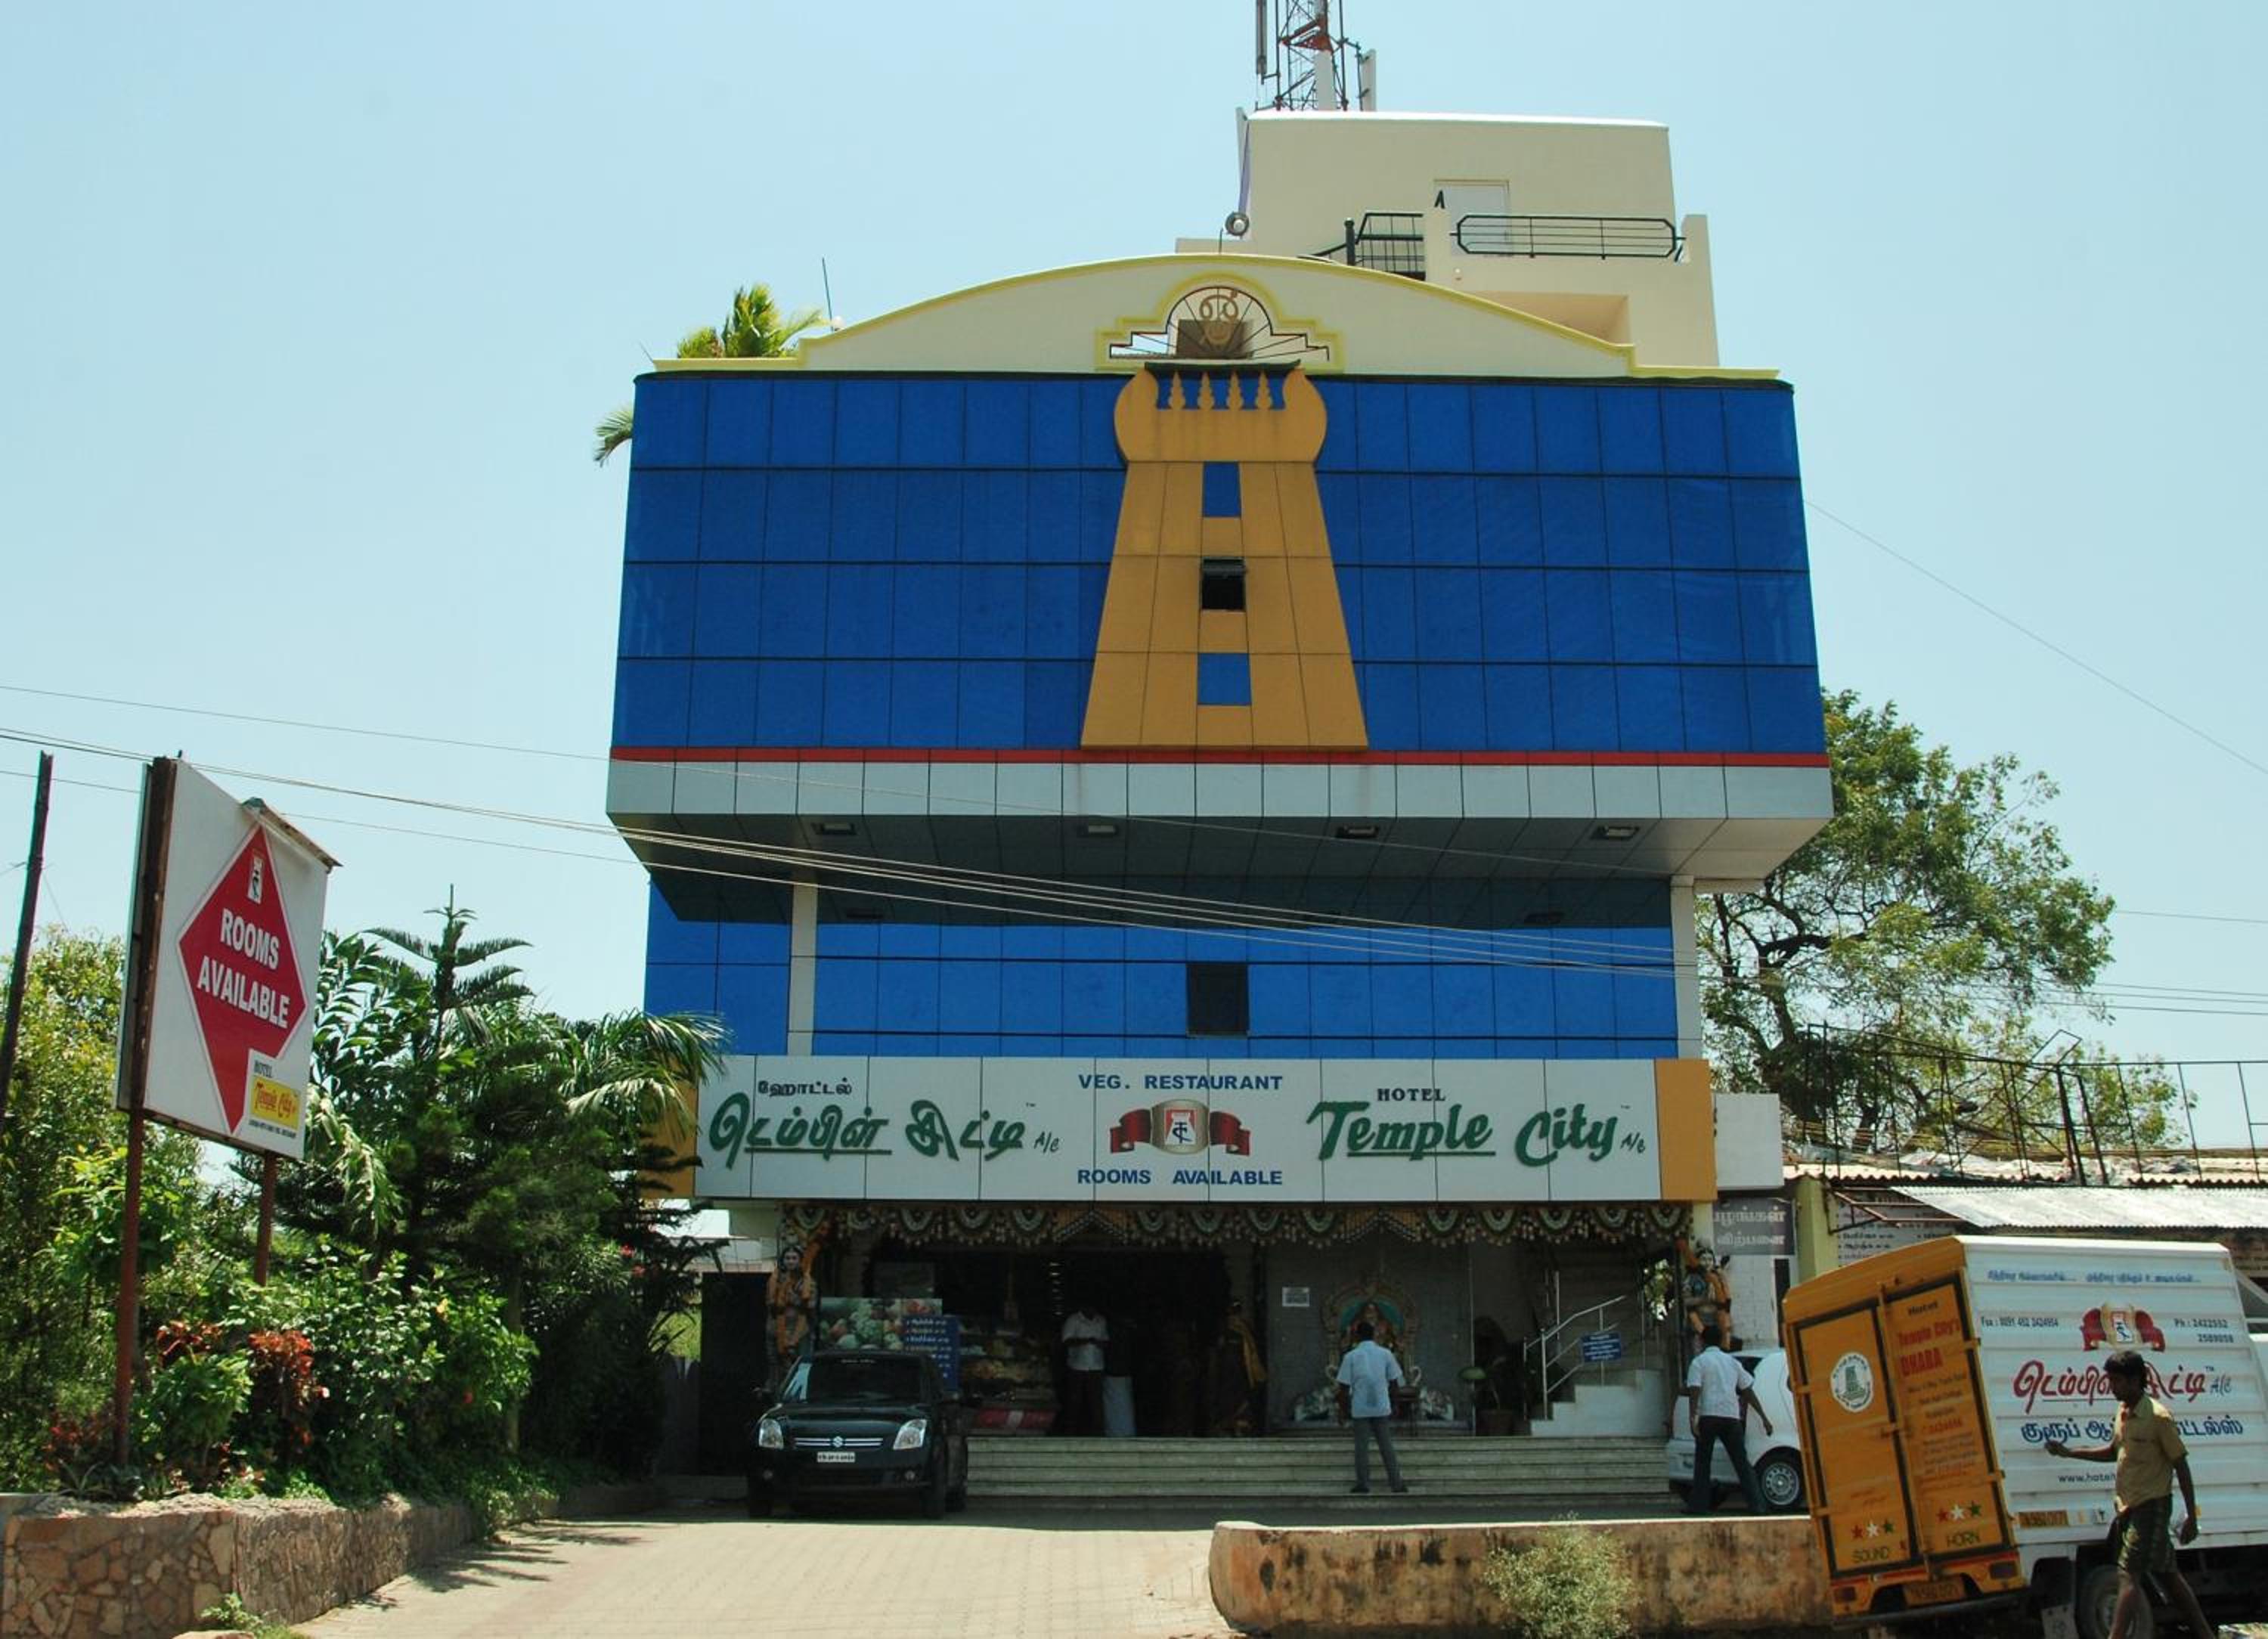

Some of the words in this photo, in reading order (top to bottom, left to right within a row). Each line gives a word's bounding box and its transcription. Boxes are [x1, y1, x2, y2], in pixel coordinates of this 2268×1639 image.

[220, 908, 279, 970] ROOMS
[197, 956, 290, 1029] AVAILABLE
[758, 1077, 852, 1097] ஹோட்டல்
[1079, 1074, 1130, 1089] VEG.
[1145, 1075, 1283, 1090] RESTAURANT
[1377, 1088, 1446, 1101] HOTEL
[905, 1099, 1026, 1162] சிட்டி
[1306, 1101, 1495, 1162] Temple
[1515, 1104, 1618, 1167] City
[1077, 1170, 1151, 1185] ROOMS
[1173, 1170, 1283, 1185] AVAILABLE
